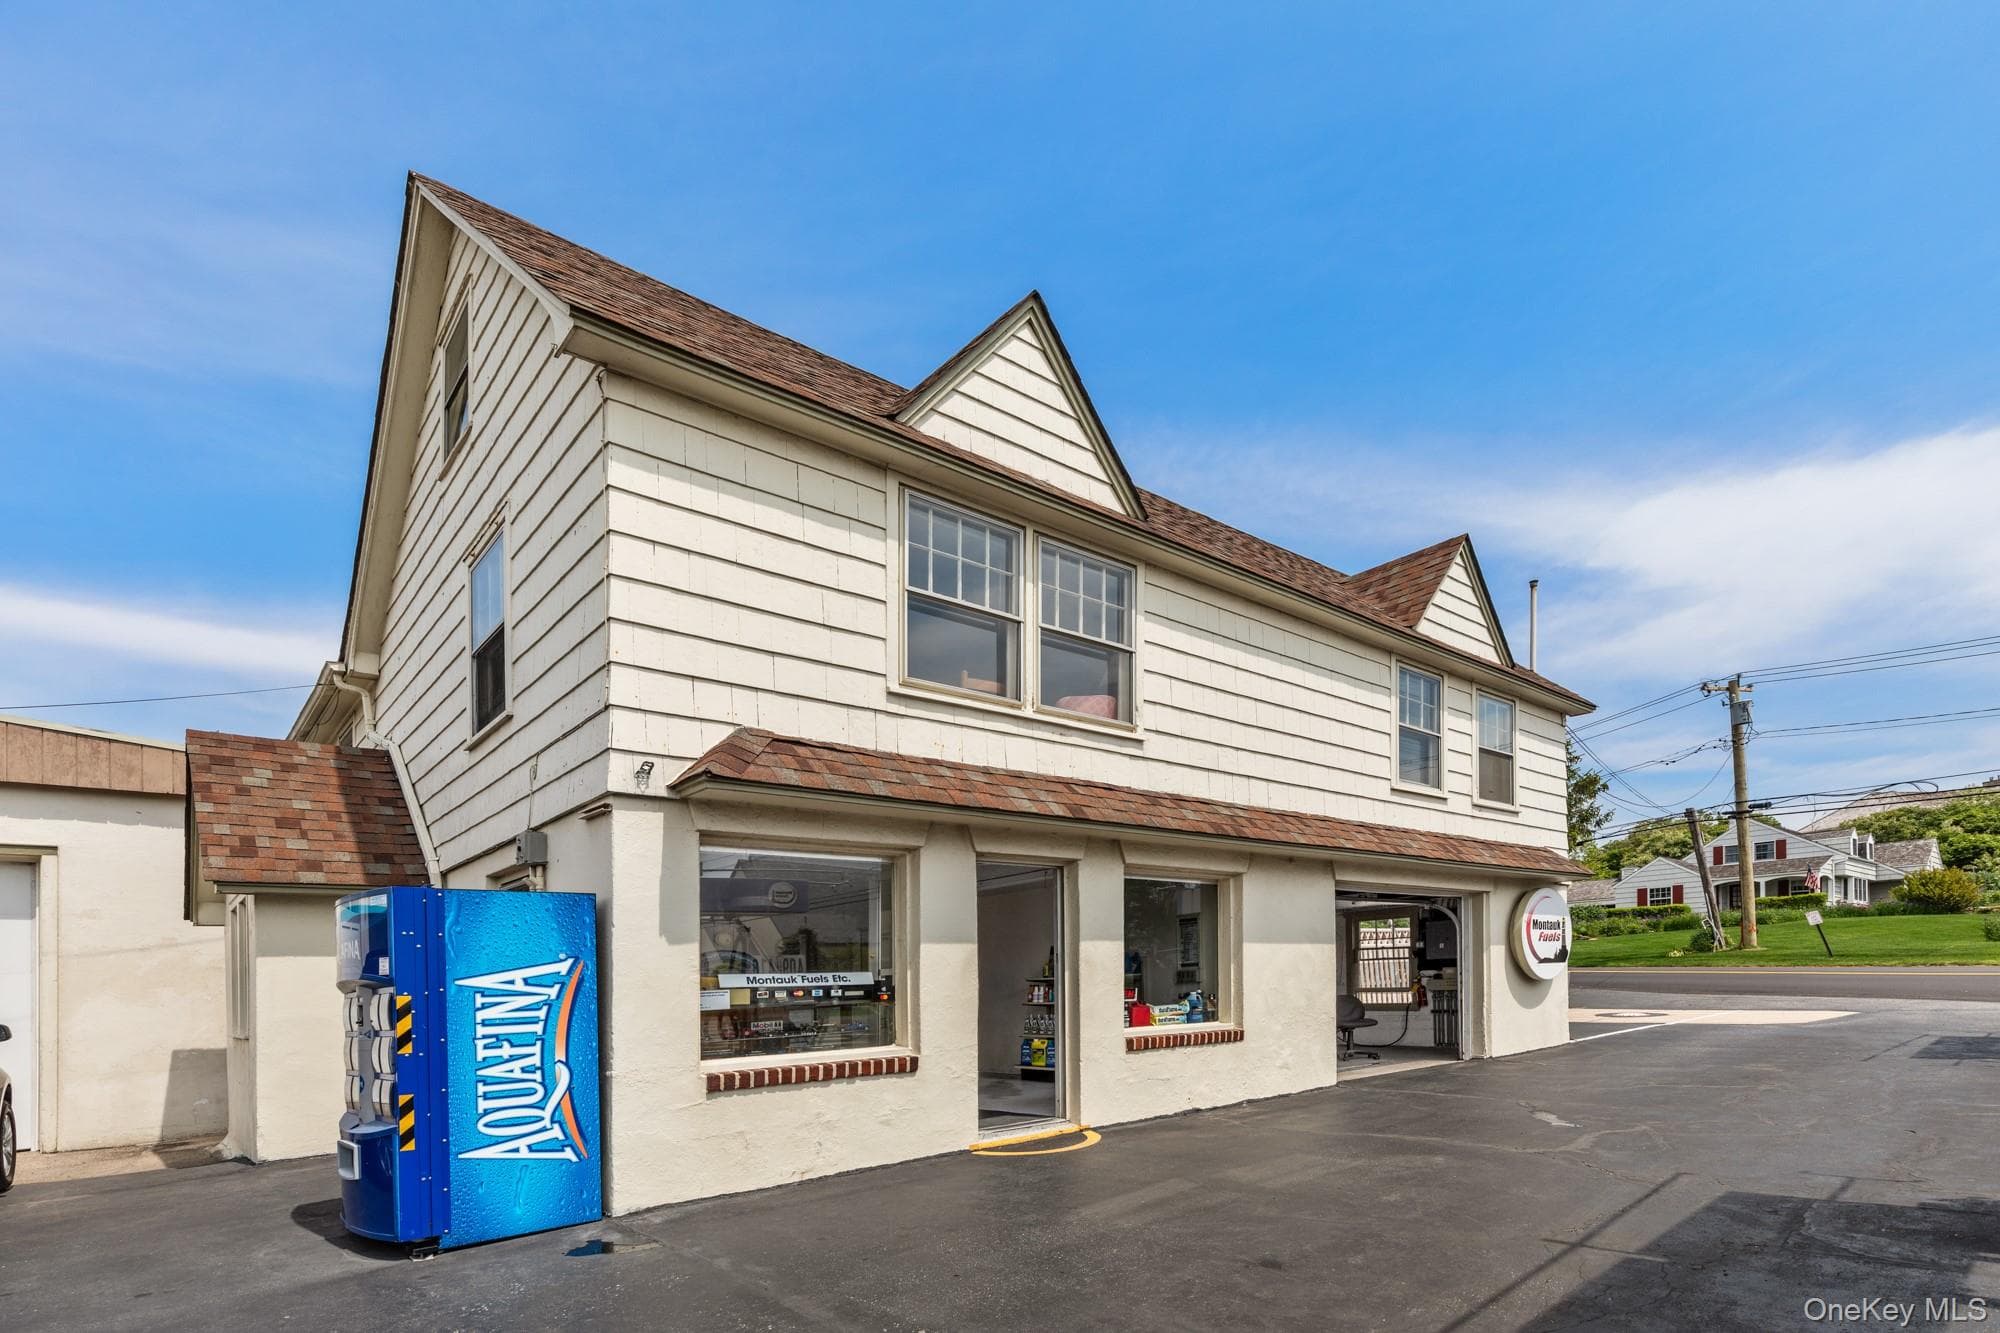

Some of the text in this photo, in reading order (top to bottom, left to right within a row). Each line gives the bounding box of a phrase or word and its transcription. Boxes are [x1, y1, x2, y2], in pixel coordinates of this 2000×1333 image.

[1532, 918, 1561, 930] Montauk
[1538, 930, 1561, 942] Fuels
[747, 974, 851, 985] Montauk Fuels Etc.
[455, 955, 579, 1163] AQUAFINA
